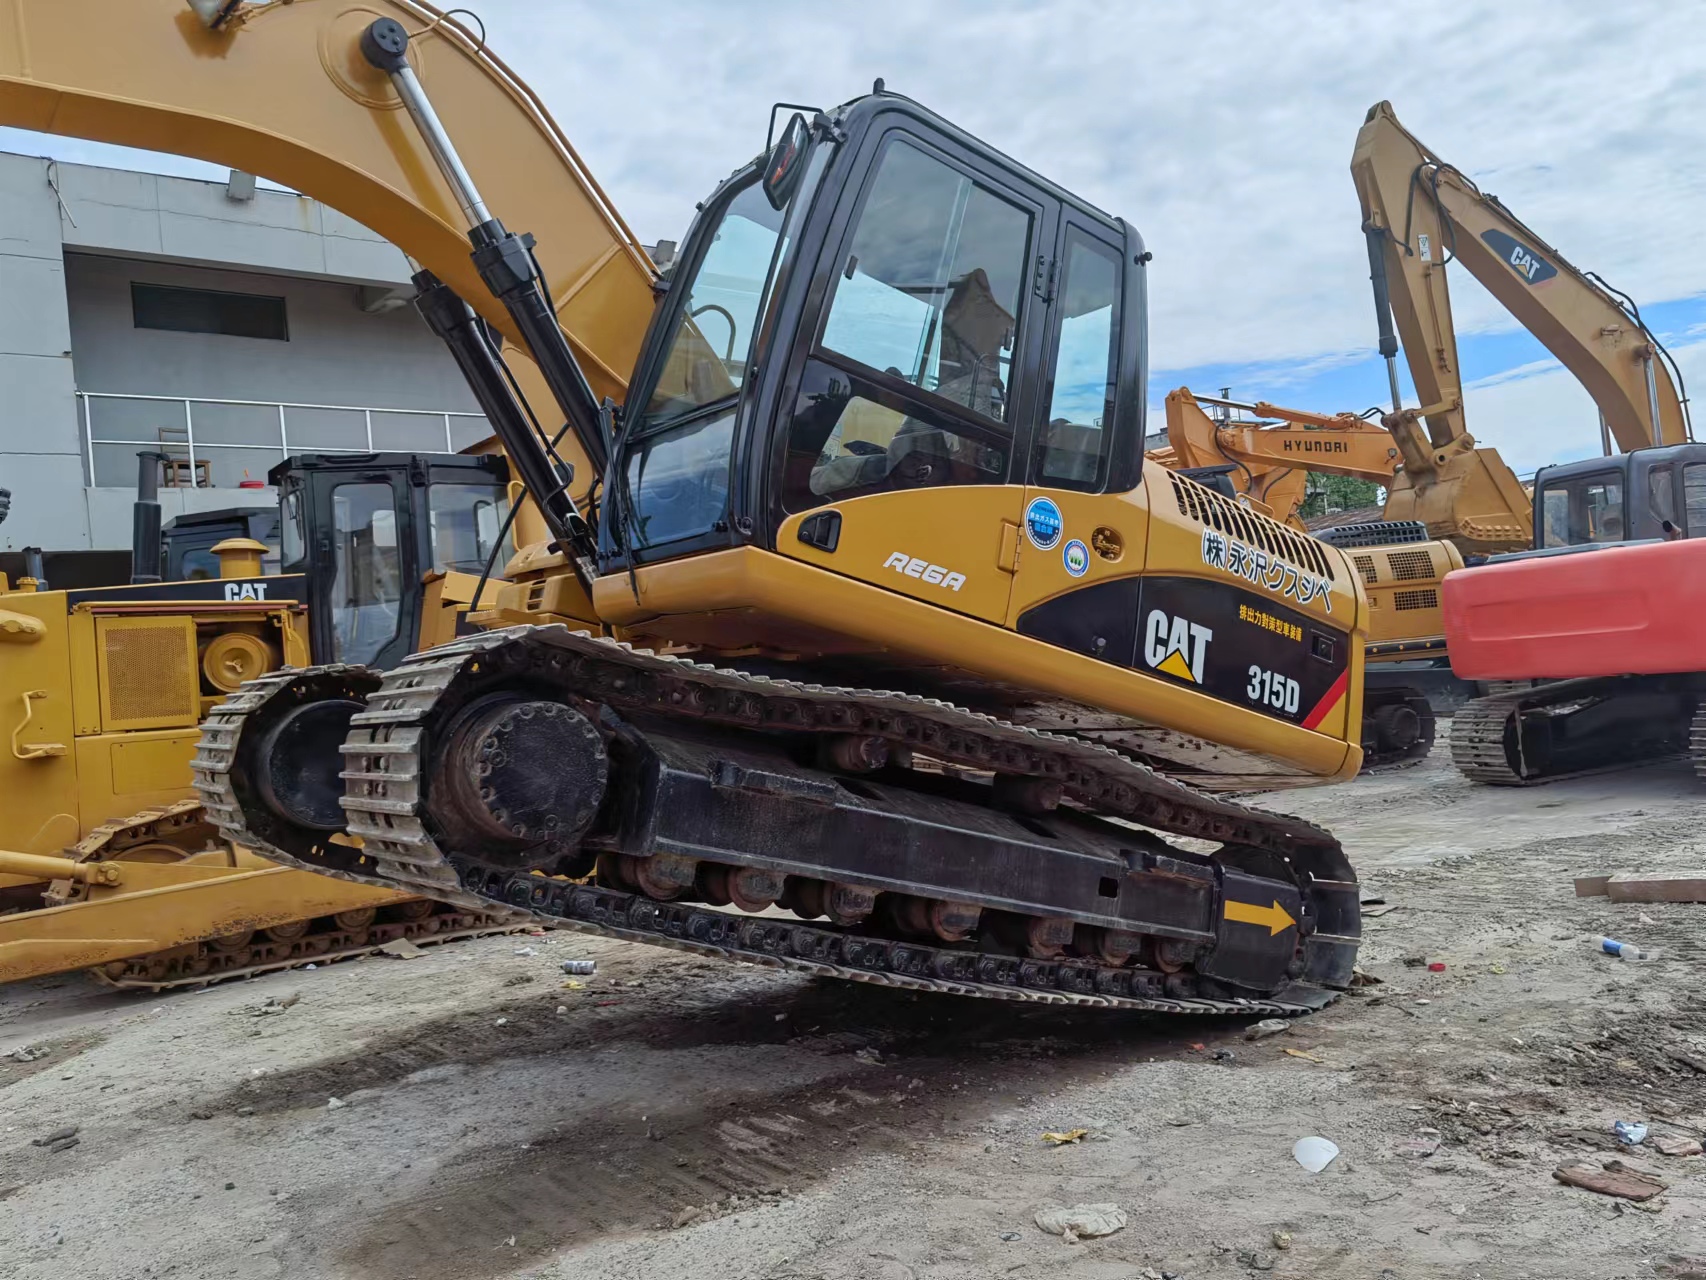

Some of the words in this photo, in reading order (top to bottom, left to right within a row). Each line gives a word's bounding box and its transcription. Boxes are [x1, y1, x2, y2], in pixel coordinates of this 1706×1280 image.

[1510, 247, 1540, 279] CAT
[1283, 440, 1347, 453] HYUNDAI
[882, 551, 966, 592] REGA
[224, 583, 268, 601] CAT
[1144, 609, 1212, 684] CAT
[1247, 665, 1300, 714] 315D
